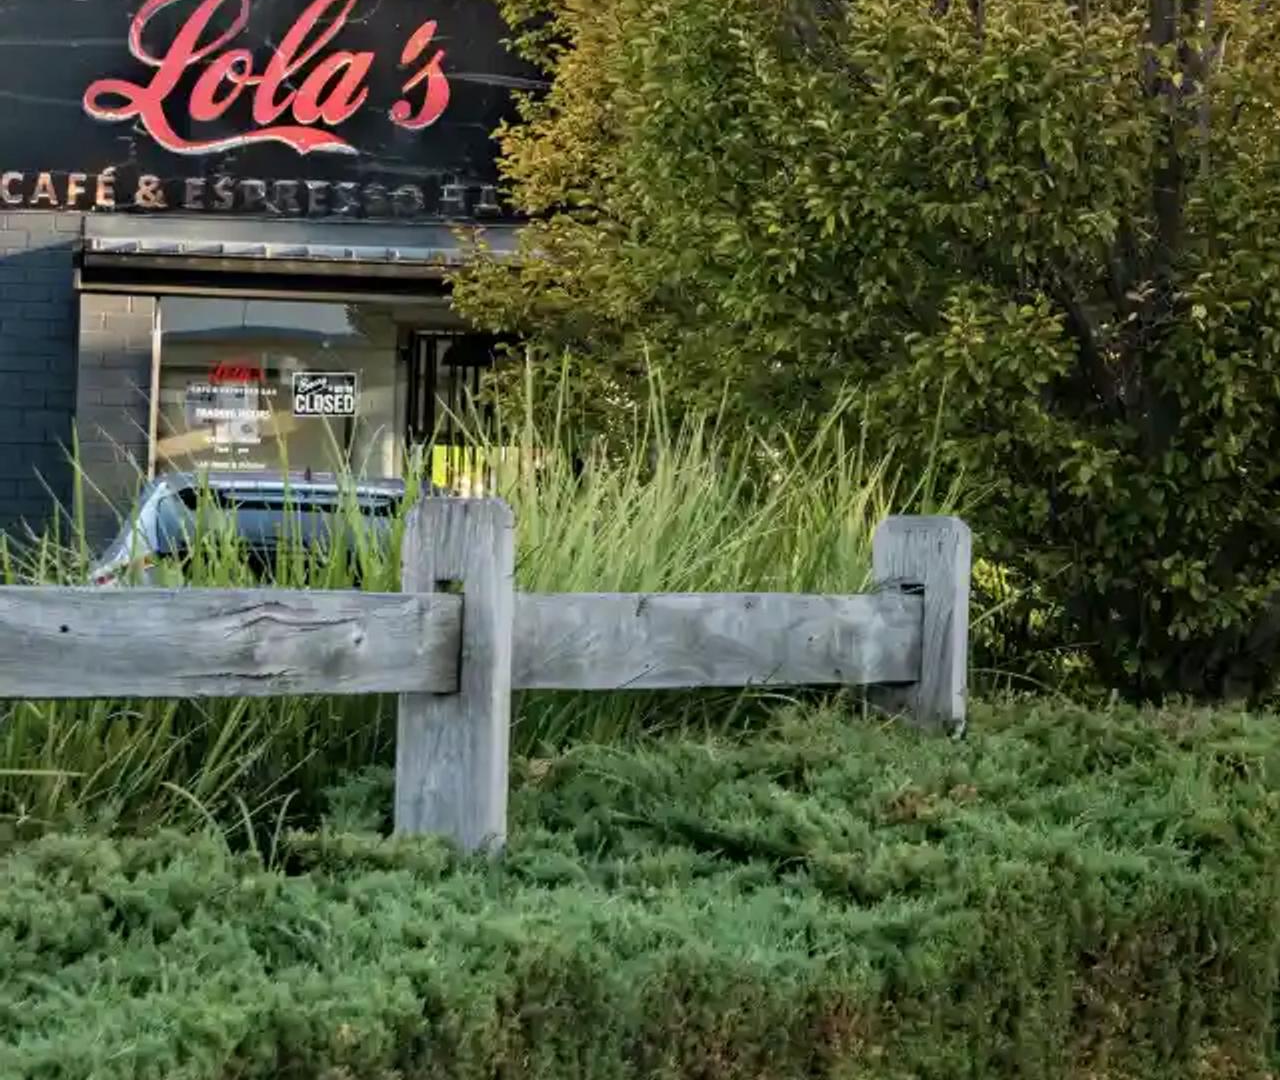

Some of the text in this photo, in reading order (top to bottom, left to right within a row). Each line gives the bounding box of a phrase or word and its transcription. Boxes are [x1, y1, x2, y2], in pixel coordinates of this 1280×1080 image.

[1, 167, 117, 206] CAFÉ
[134, 174, 168, 208] &
[295, 394, 354, 413] CLOSED
